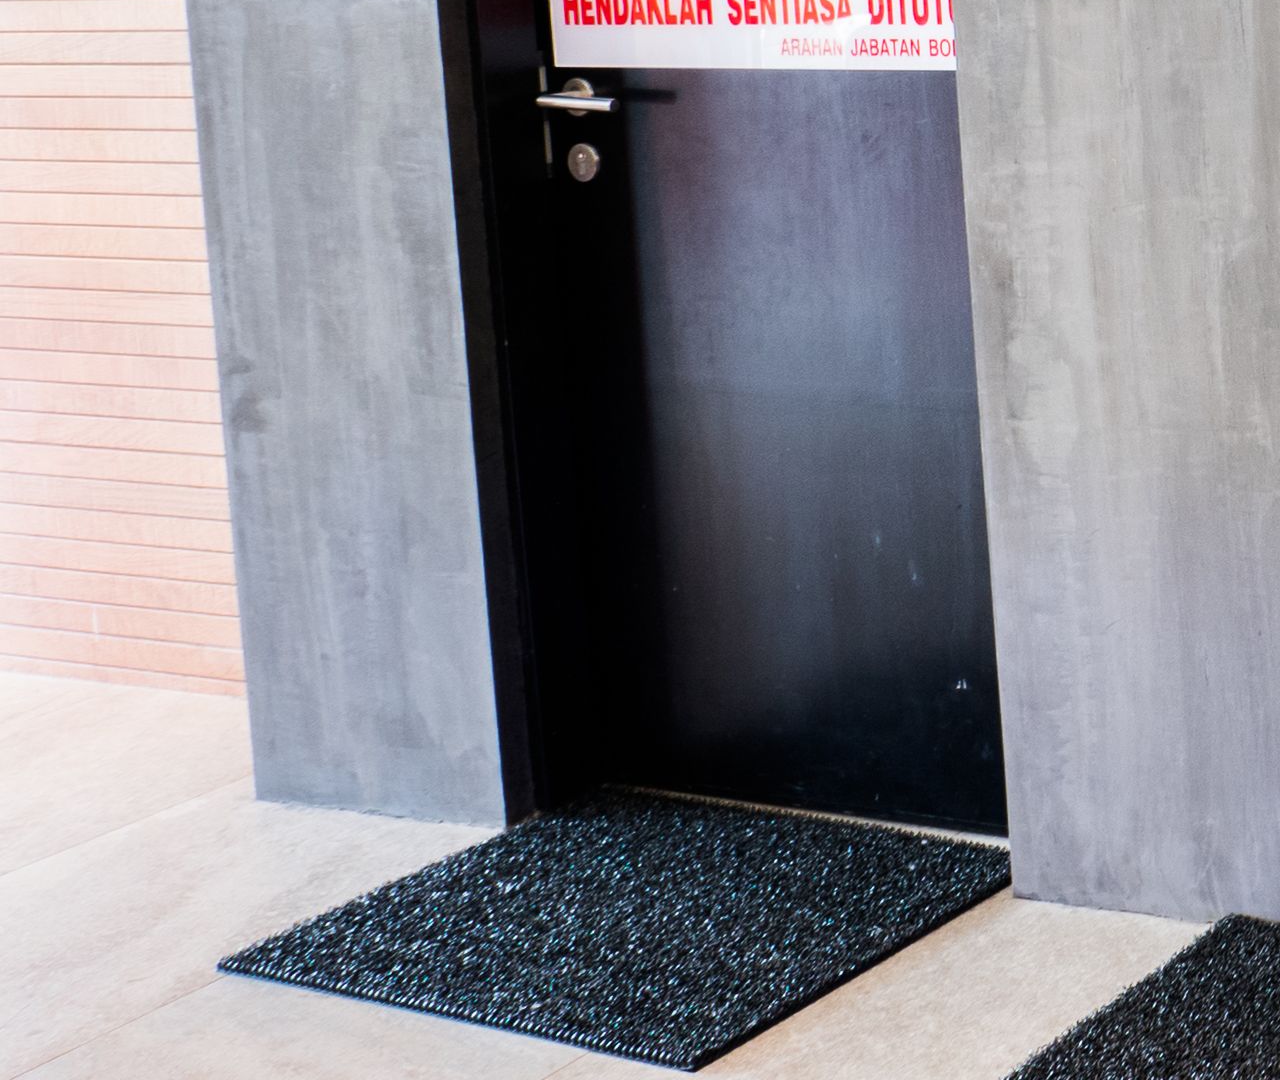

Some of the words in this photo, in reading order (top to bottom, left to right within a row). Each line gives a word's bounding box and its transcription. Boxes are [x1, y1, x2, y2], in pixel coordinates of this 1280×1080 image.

[781, 38, 842, 56] ARAHAN
[851, 38, 920, 57] JABATAN
[929, 39, 956, 57] BO
